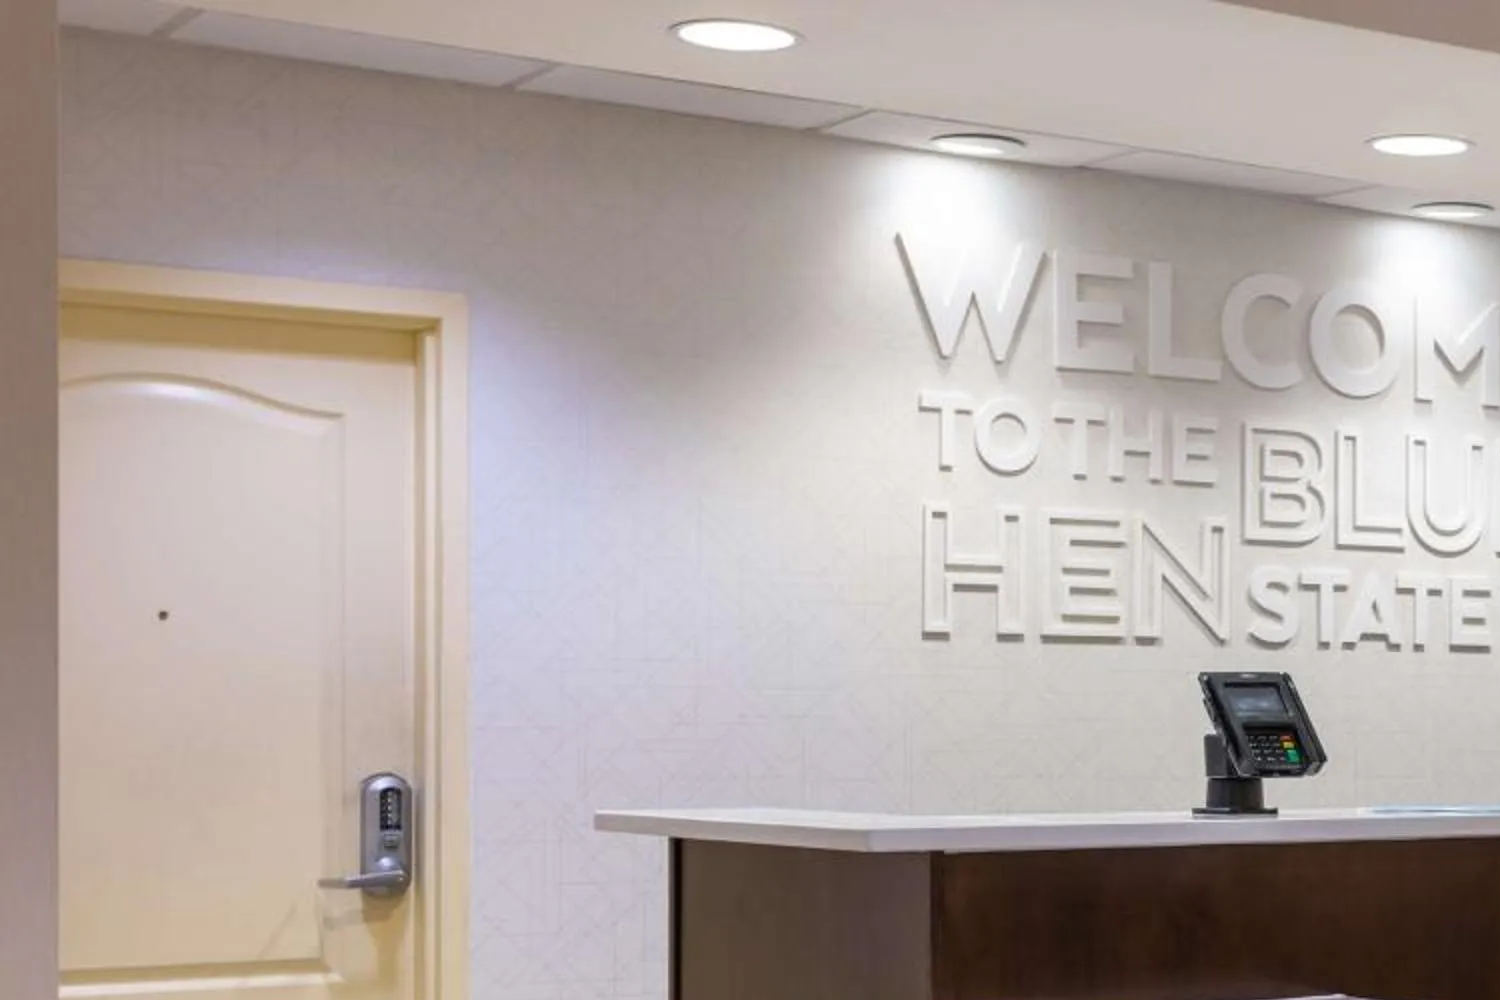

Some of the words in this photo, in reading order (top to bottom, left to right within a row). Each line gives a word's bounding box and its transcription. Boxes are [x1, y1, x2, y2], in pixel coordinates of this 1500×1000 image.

[918, 389, 1042, 476] TO
[1053, 401, 1219, 488] THE
[921, 502, 1232, 646] HEN
[1247, 563, 1492, 653] STATE
